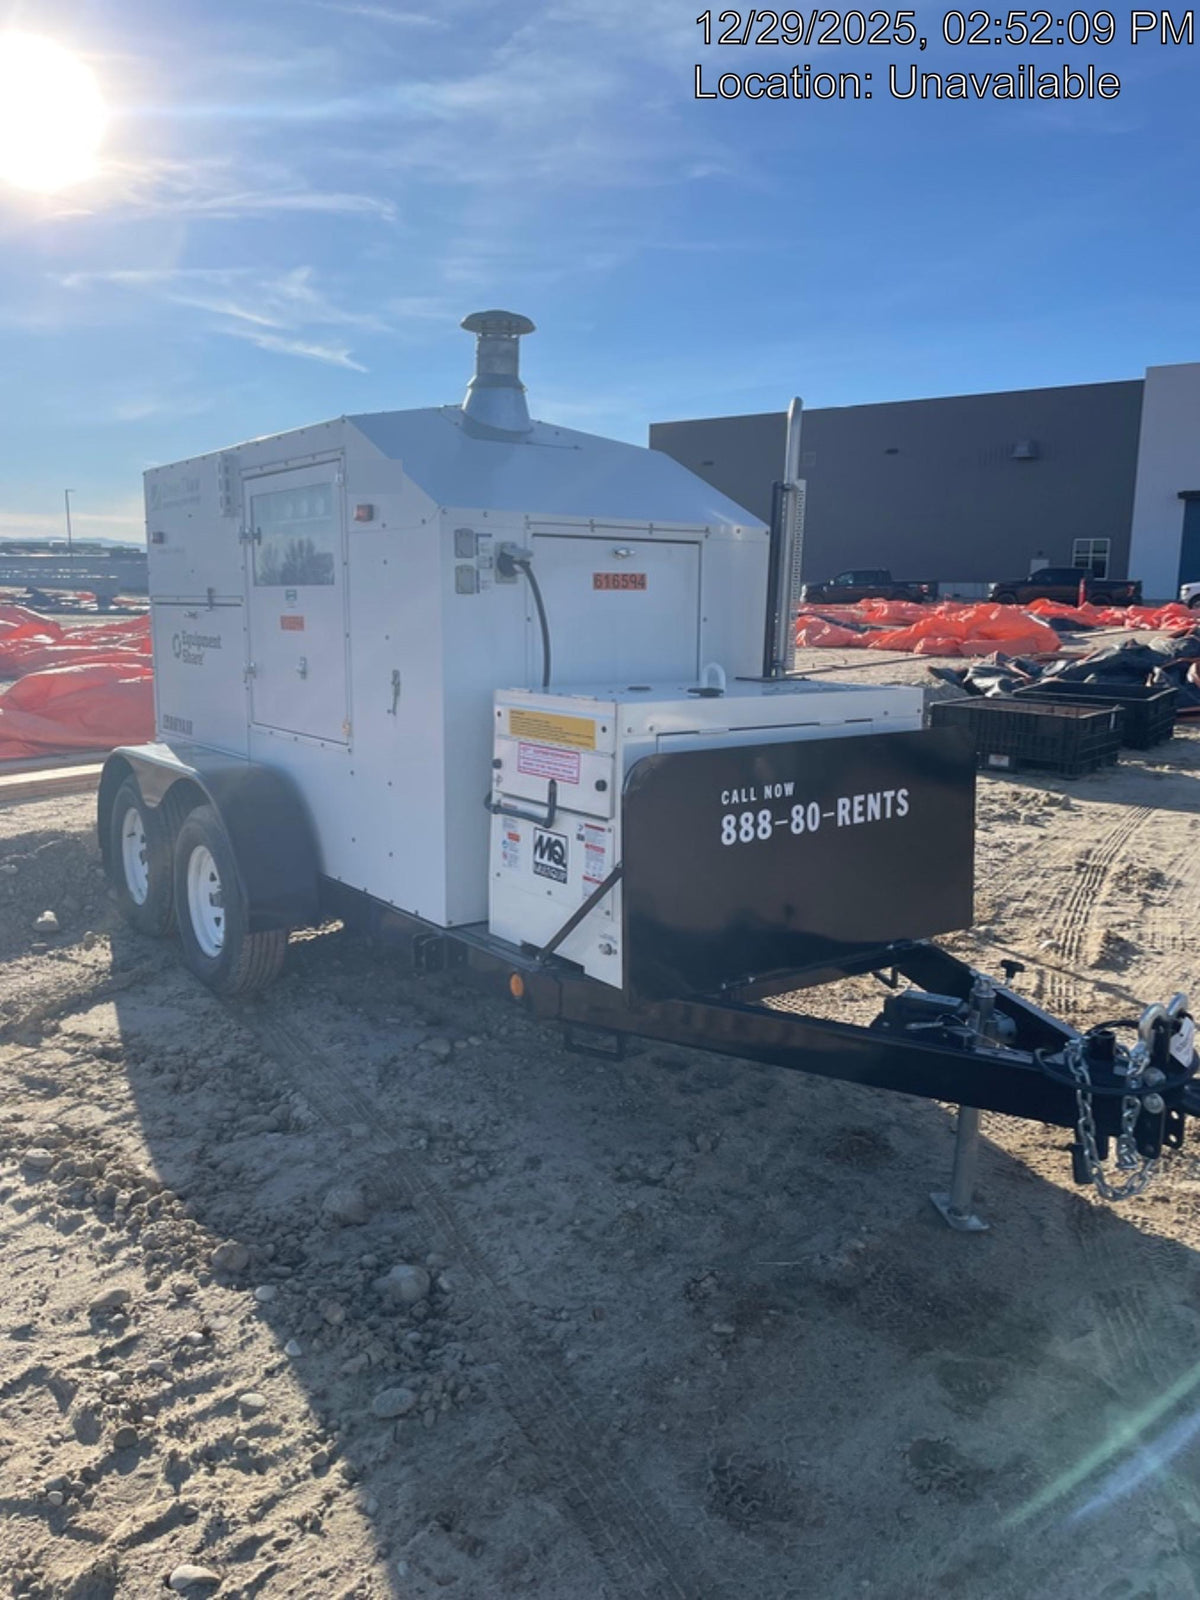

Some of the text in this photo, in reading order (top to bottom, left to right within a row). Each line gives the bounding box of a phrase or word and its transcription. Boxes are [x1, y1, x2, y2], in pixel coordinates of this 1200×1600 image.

[594, 573, 647, 589] 616594
[721, 782, 795, 805] CALL NOW
[721, 788, 909, 845] 888-80-RENTS
[534, 834, 567, 867] MQ
